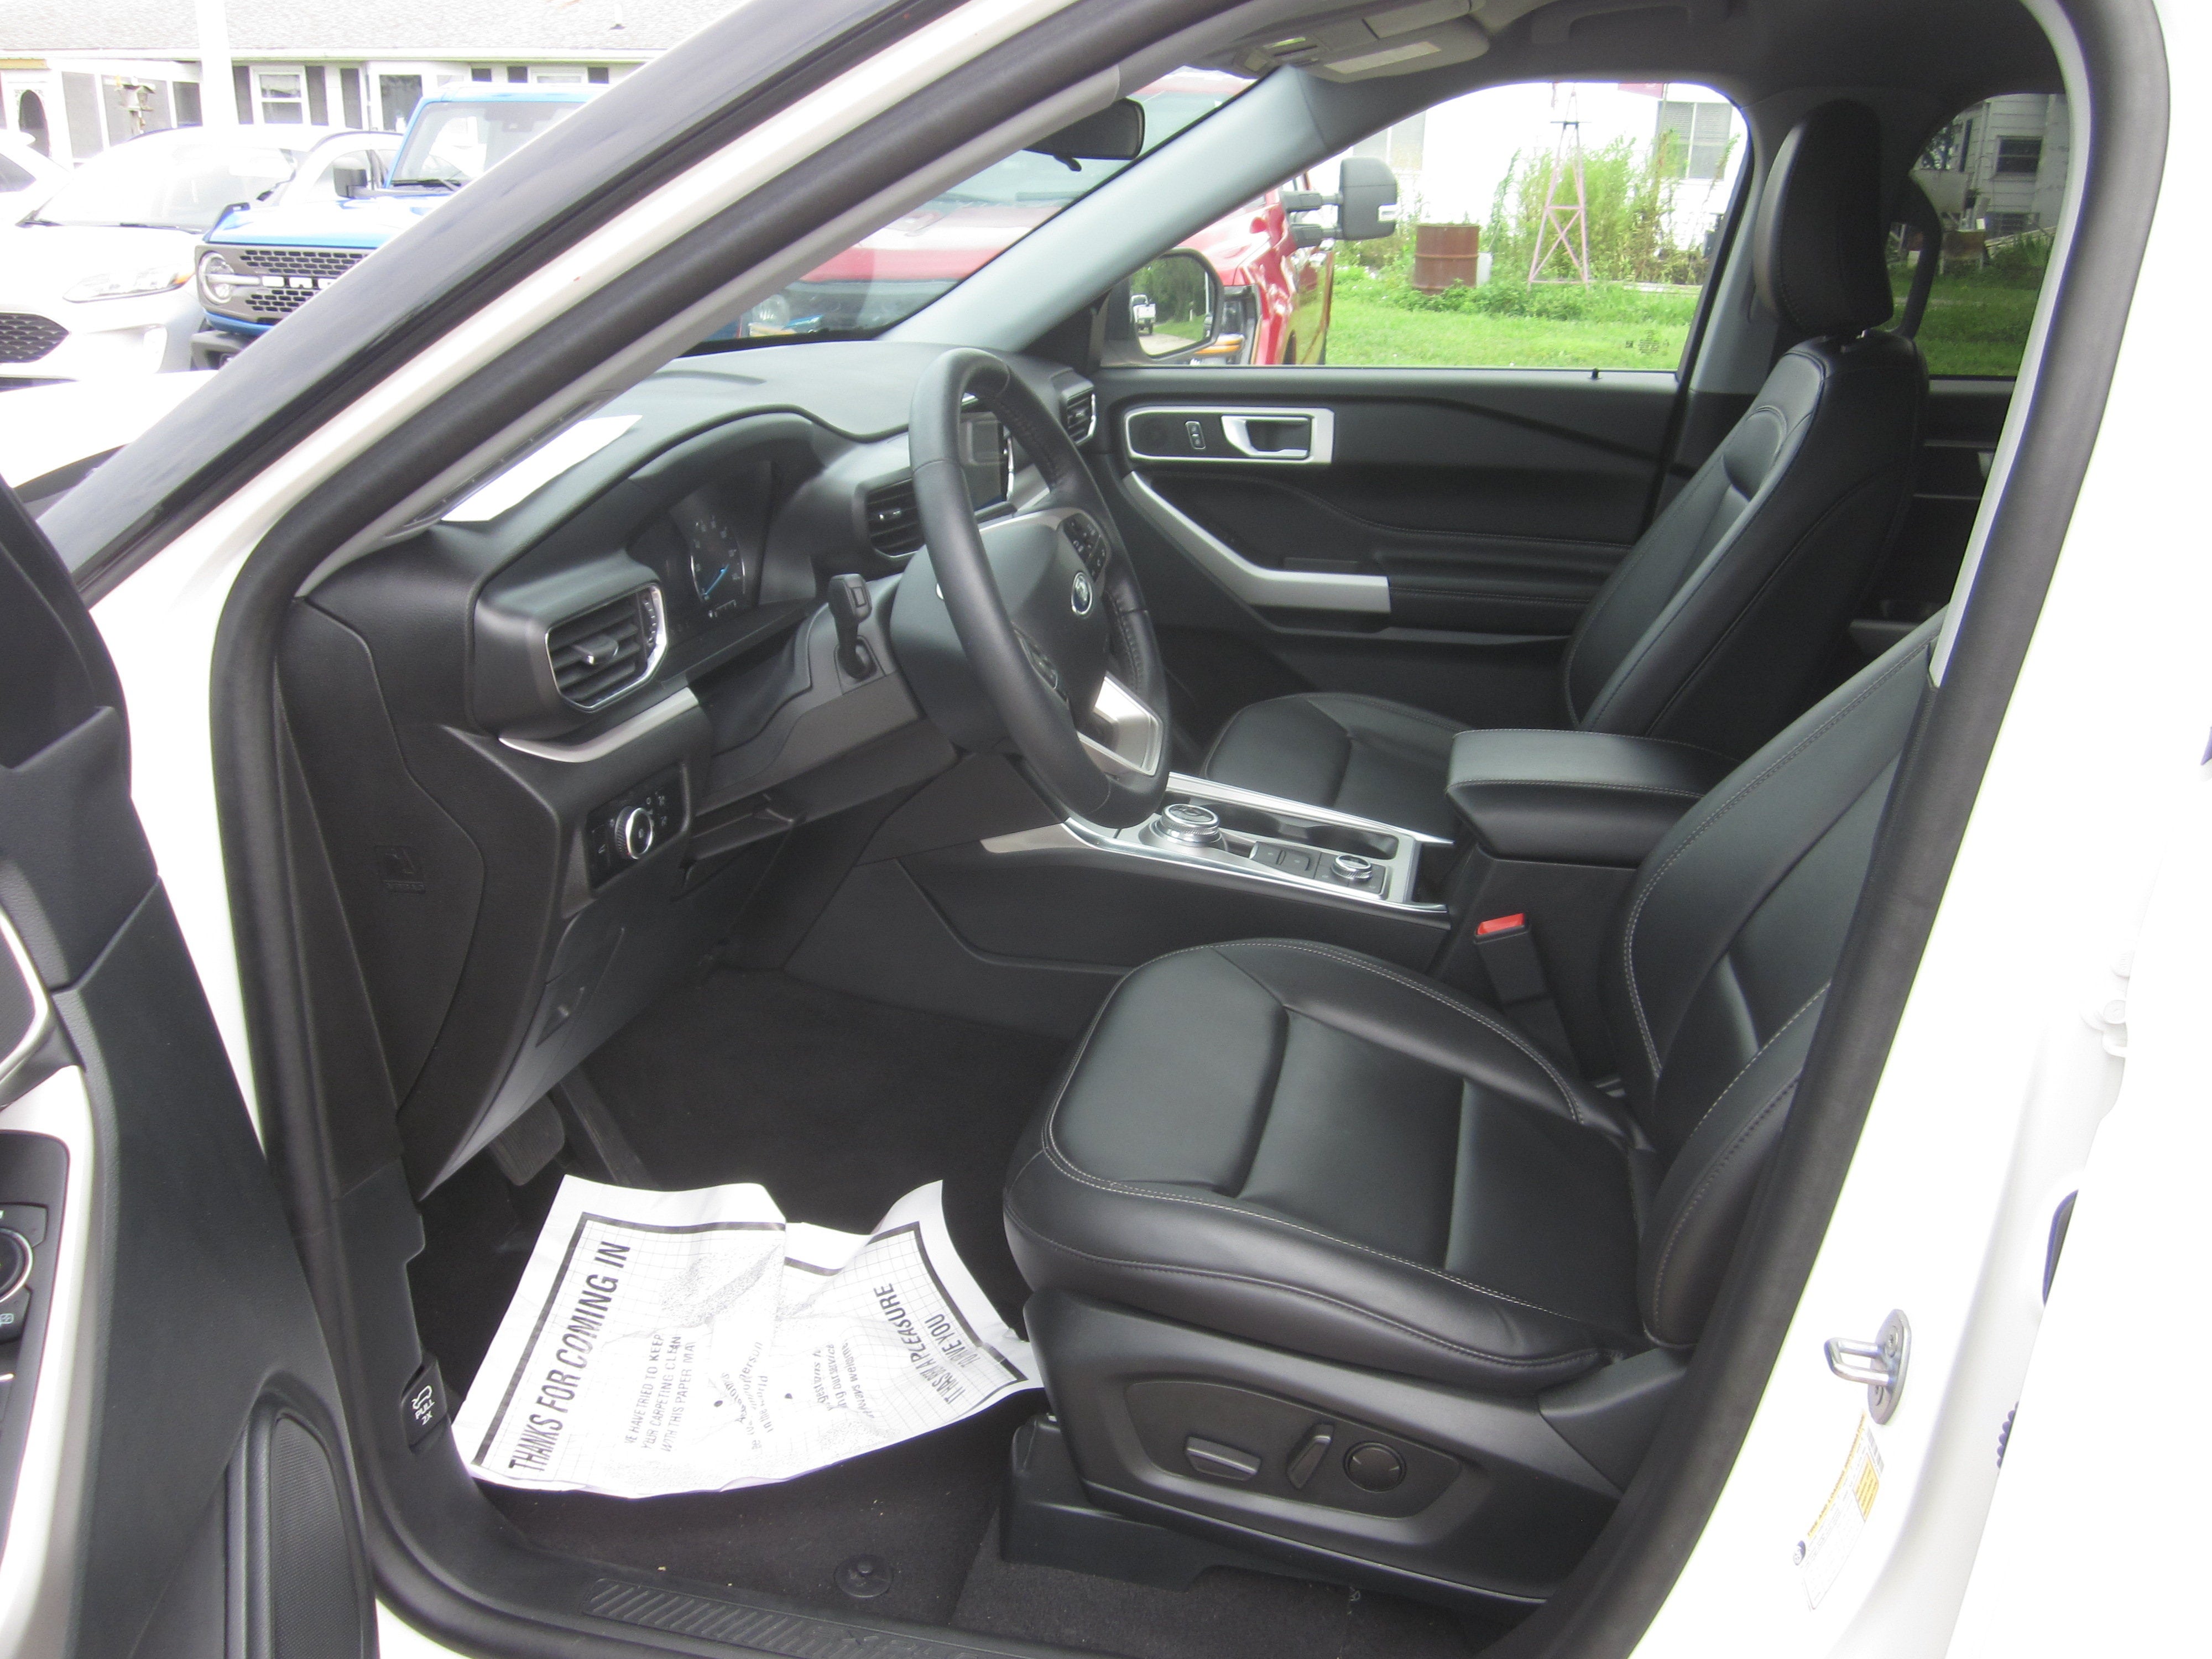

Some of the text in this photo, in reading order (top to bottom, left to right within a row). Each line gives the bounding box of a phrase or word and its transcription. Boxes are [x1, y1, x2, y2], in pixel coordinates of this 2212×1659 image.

[873, 1283, 931, 1363] PLEASURE
[924, 1314, 955, 1345] YOU
[508, 1241, 630, 1472] THANKS FOR COMING IN
[649, 1334, 664, 1361] KEEP
[915, 1358, 937, 1370] A
[957, 1353, 982, 1368] TO
[645, 1366, 658, 1380] TO
[649, 1375, 674, 1426] CARPETING
[665, 1337, 682, 1370] CLEAN
[831, 1375, 842, 1390] our
[636, 1384, 654, 1407] TRIED
[675, 1369, 692, 1403] PAPER
[931, 1372, 959, 1397] HAS
[944, 1386, 966, 1405] IT
[415, 1399, 435, 1420] PULL
[421, 1411, 432, 1426] 2X
[667, 1407, 684, 1426] THIS
[628, 1409, 646, 1433] HAVE
[660, 1430, 677, 1452] WITH
